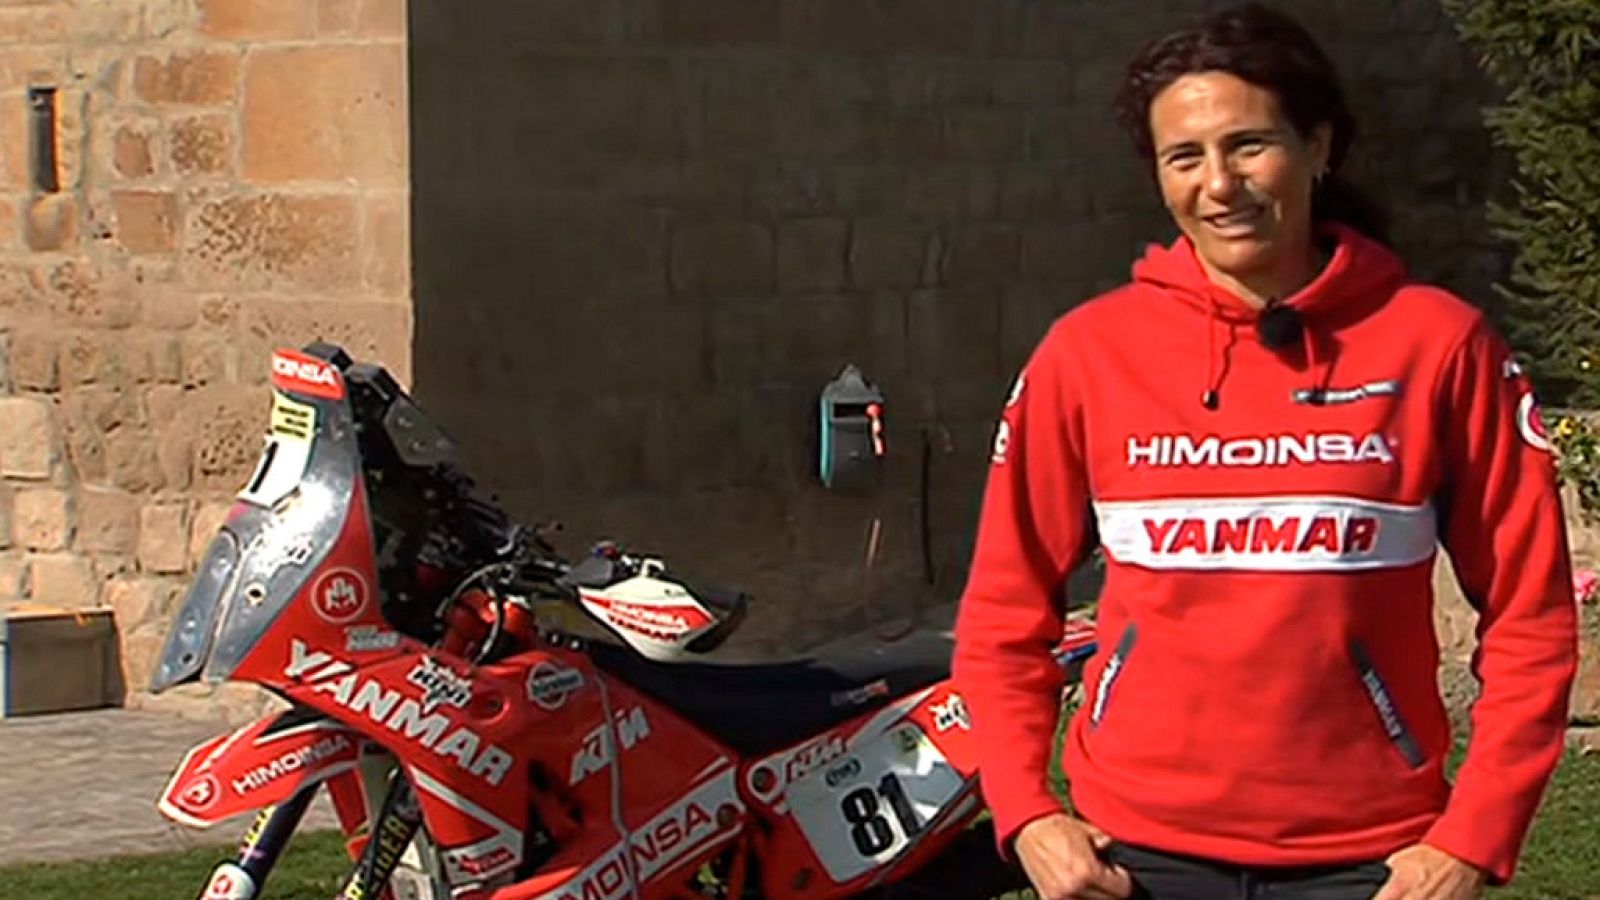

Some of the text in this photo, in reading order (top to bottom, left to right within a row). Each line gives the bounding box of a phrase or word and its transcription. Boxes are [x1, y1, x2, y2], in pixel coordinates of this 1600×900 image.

[1127, 434, 1393, 467] HIMOINSA
[1142, 516, 1378, 554] YANMAR
[284, 640, 513, 787] YANMAR
[841, 771, 920, 856] 81
